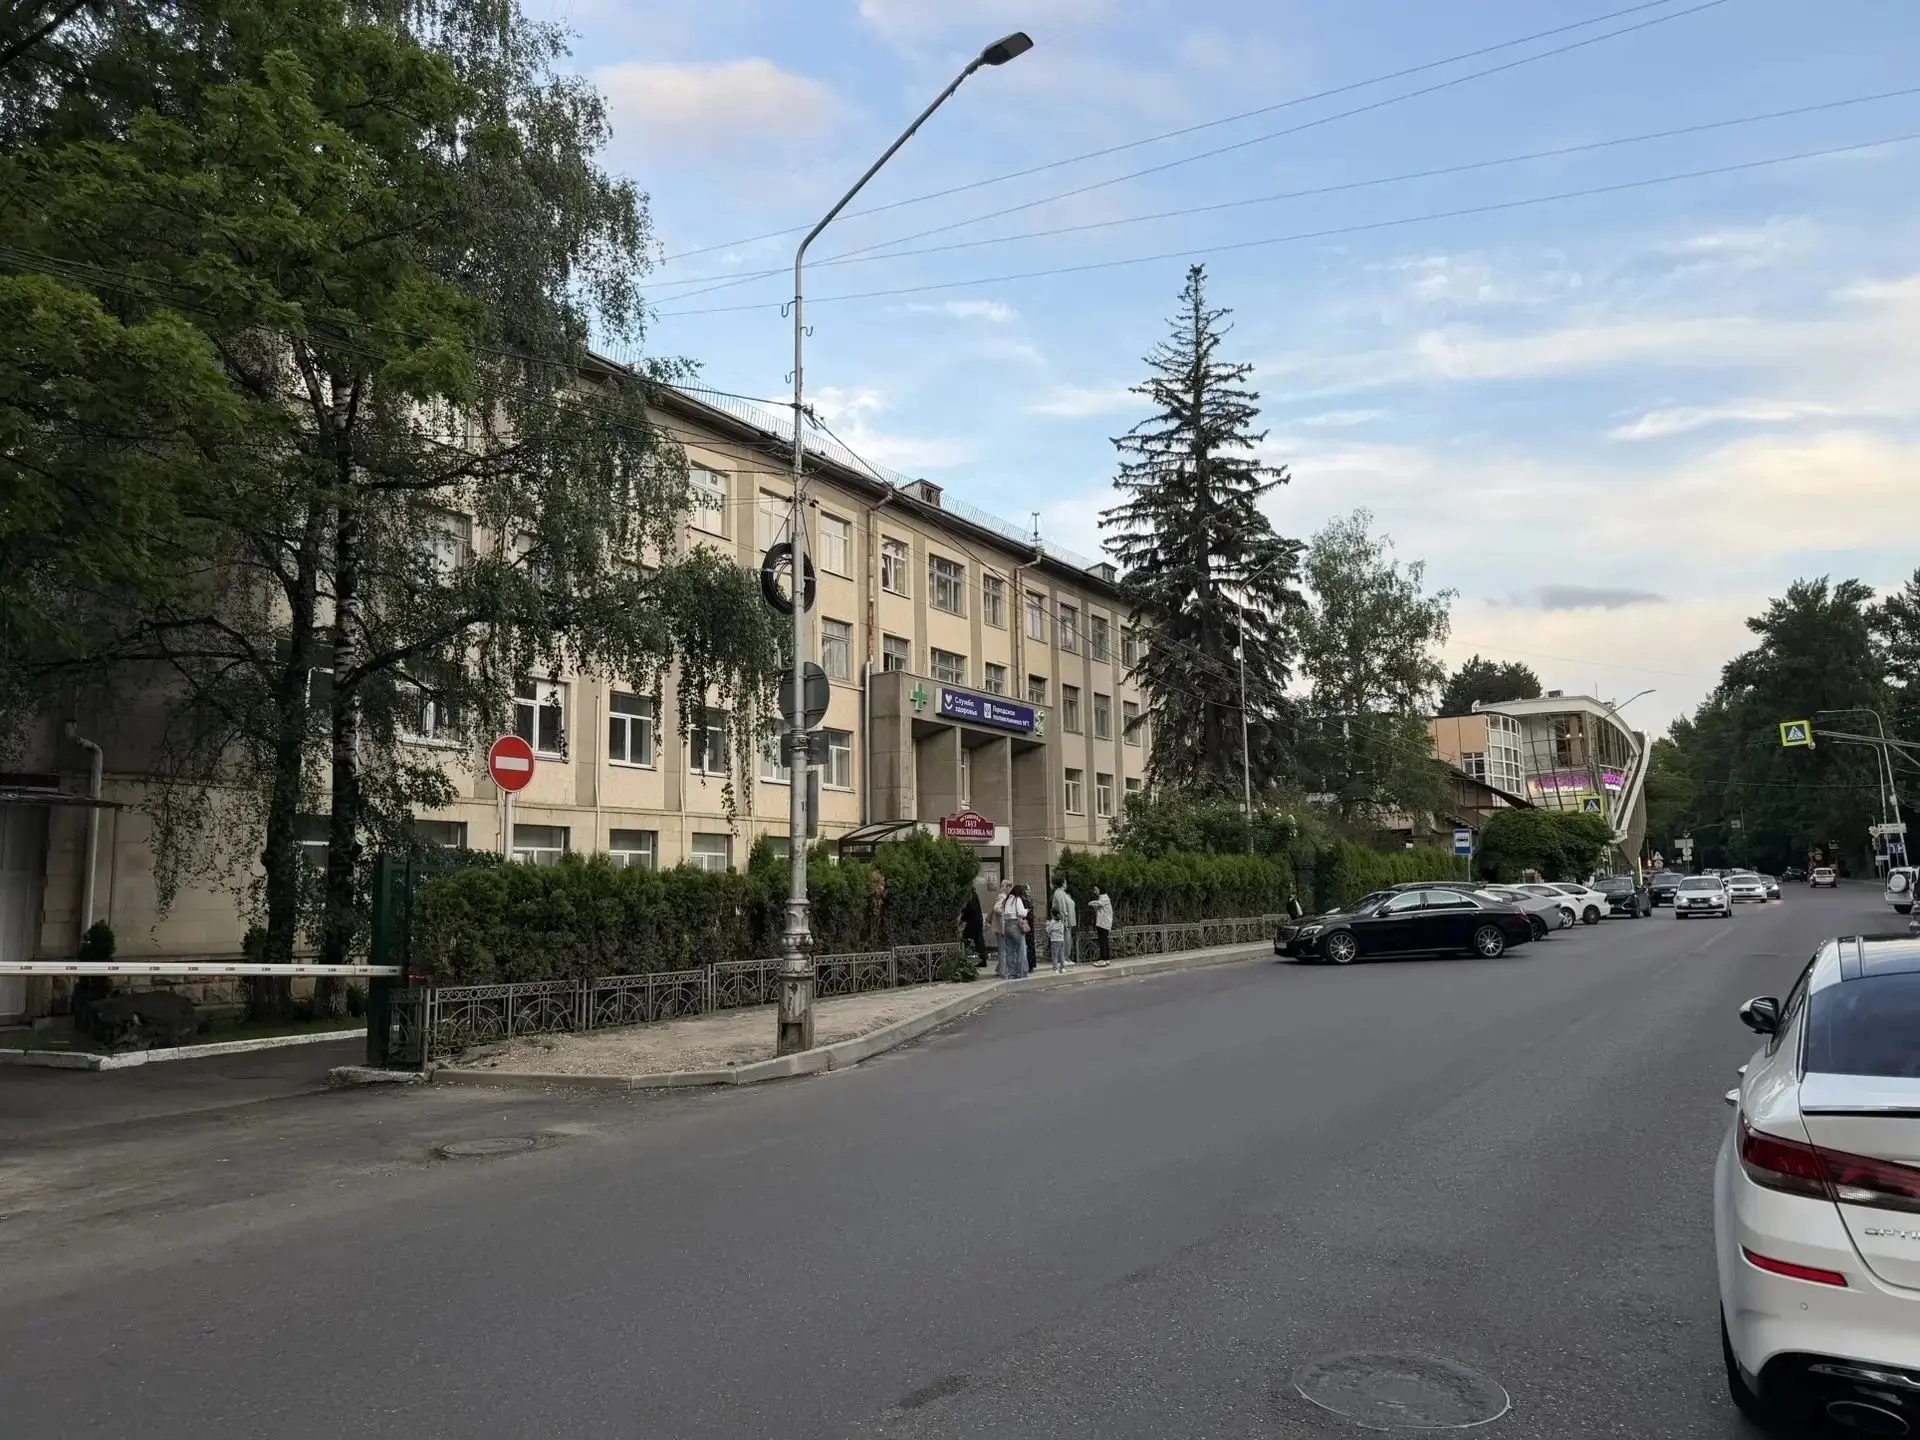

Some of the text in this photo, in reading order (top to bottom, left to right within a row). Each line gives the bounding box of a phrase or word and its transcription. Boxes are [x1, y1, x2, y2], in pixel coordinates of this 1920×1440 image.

[954, 696, 974, 706] Служба
[955, 706, 978, 716] здоровья
[992, 706, 1016, 716] Городская
[992, 715, 1022, 726] поликлиника
[948, 828, 986, 836] ПОЛИКЛИНИКА
[1864, 1228, 1920, 1240] OPTI
